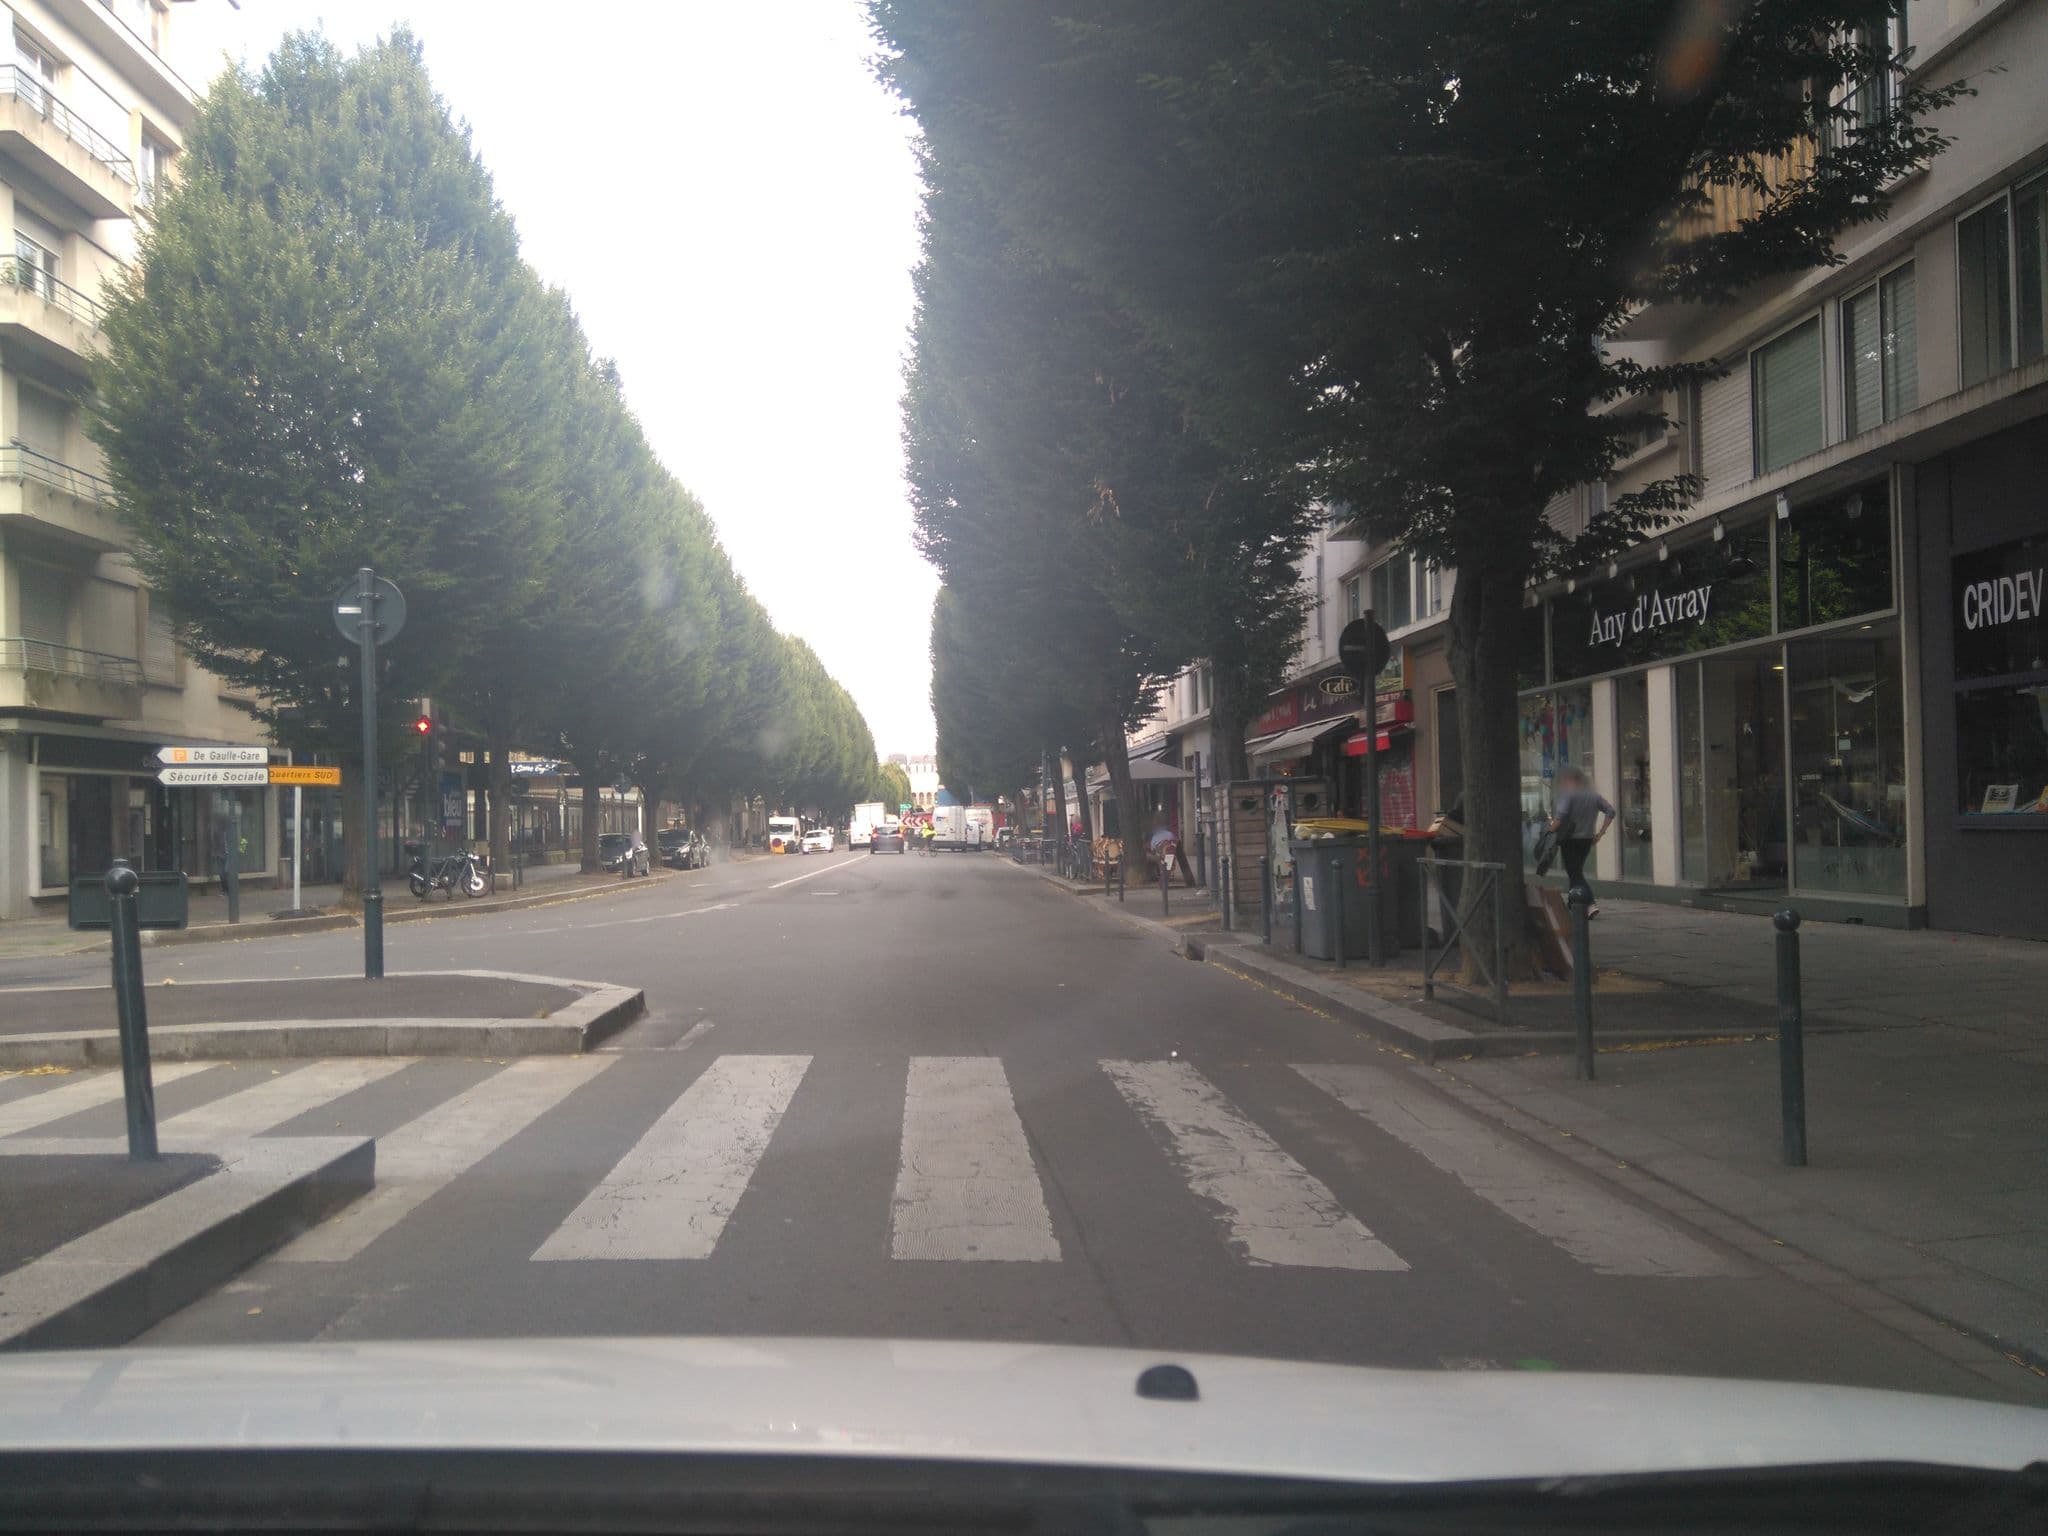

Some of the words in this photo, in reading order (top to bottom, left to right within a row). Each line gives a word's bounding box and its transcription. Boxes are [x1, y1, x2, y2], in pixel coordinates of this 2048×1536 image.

[1964, 567, 2043, 630] CRIDEV
[1589, 609, 1626, 648] Any
[1632, 585, 1712, 633] d'Avray
[194, 751, 204, 761] De
[210, 751, 261, 761] Gaulle-Gare
[169, 771, 218, 782] Sécurité
[222, 771, 264, 782] Sociale
[314, 771, 333, 779] SUD
